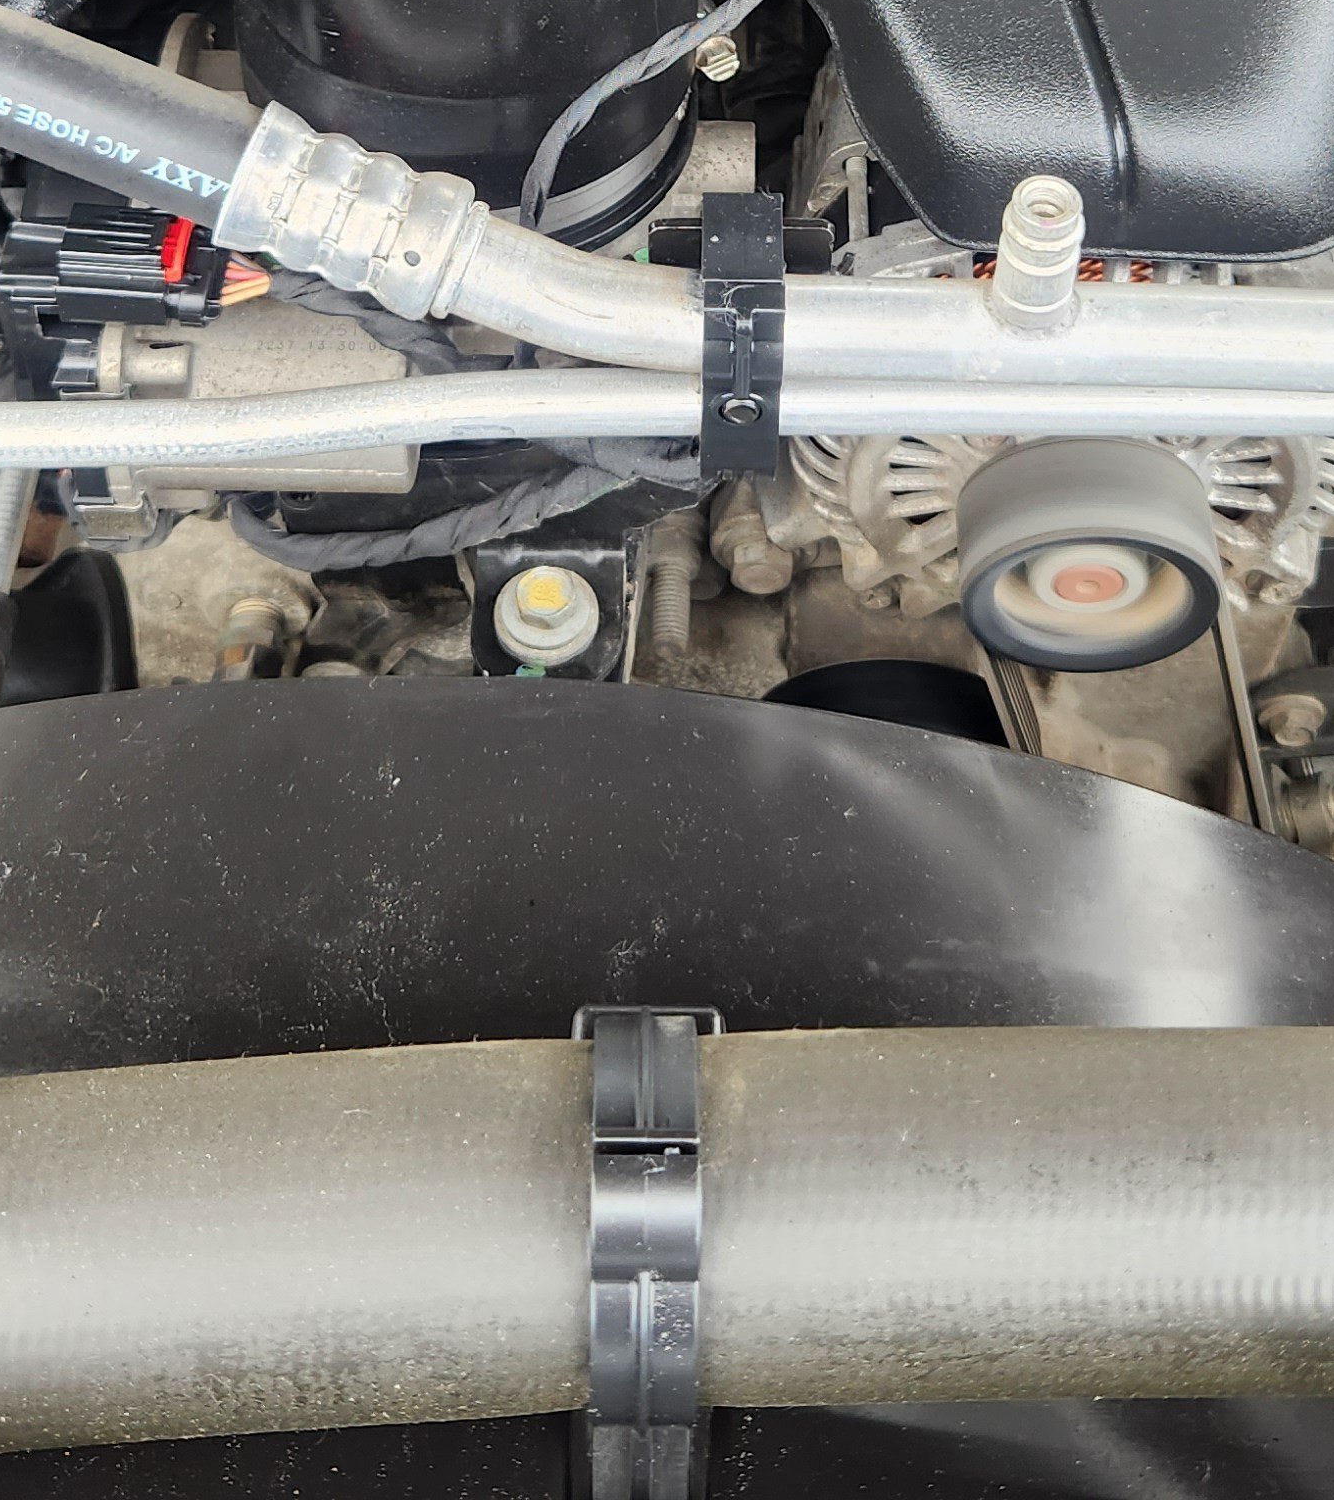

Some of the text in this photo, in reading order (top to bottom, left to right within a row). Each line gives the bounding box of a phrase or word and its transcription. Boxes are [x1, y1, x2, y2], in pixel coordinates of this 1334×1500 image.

[13, 102, 90, 147] HOSE
[90, 135, 141, 164] A/C
[139, 156, 232, 198] AXY
